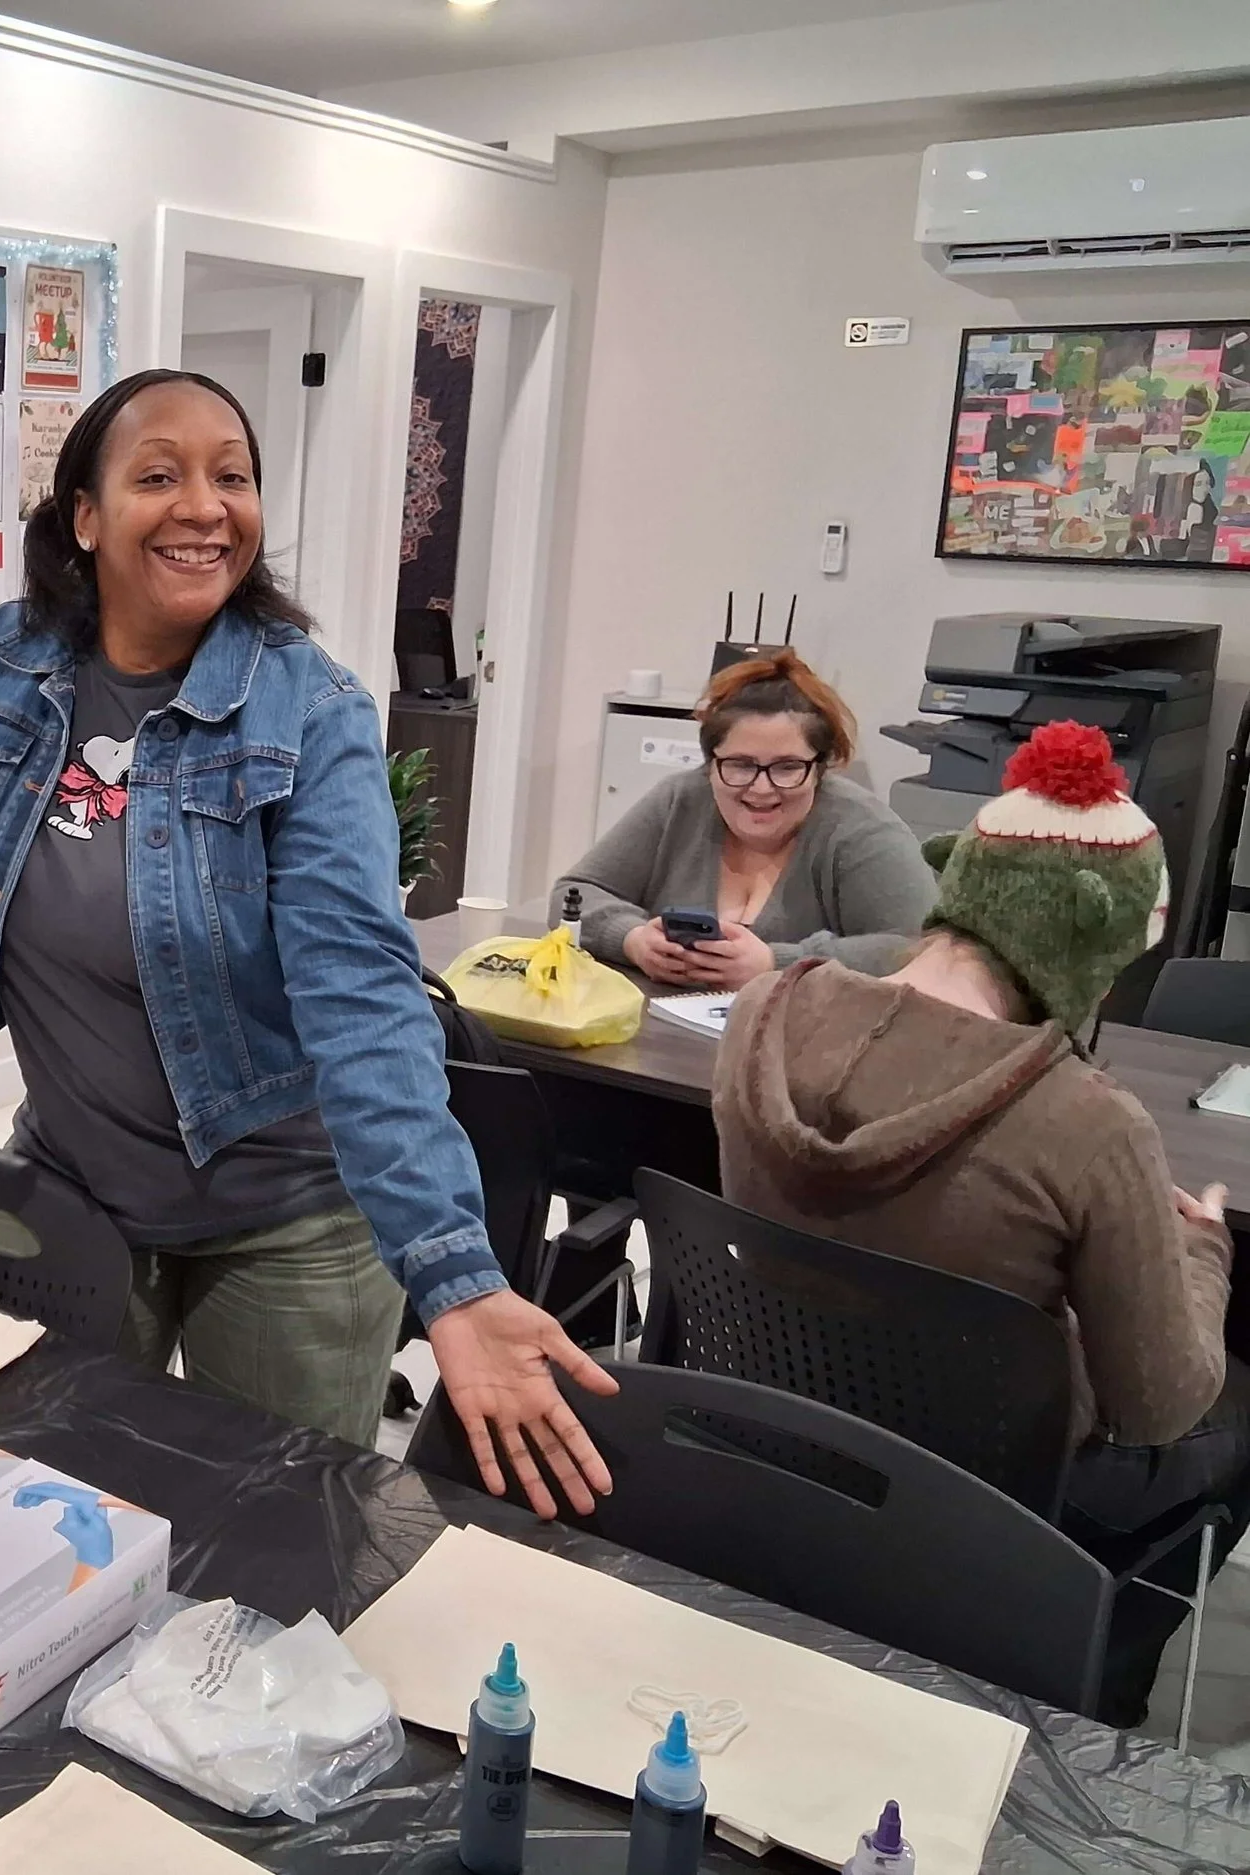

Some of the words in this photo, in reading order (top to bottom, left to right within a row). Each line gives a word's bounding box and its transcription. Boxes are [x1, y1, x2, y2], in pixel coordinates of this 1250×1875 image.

[35, 283, 72, 298] MEETUP
[984, 505, 1010, 521] ME
[17, 1655, 45, 1679] Nitro
[48, 1624, 79, 1655] Touch
[482, 1766, 501, 1784] TIE
